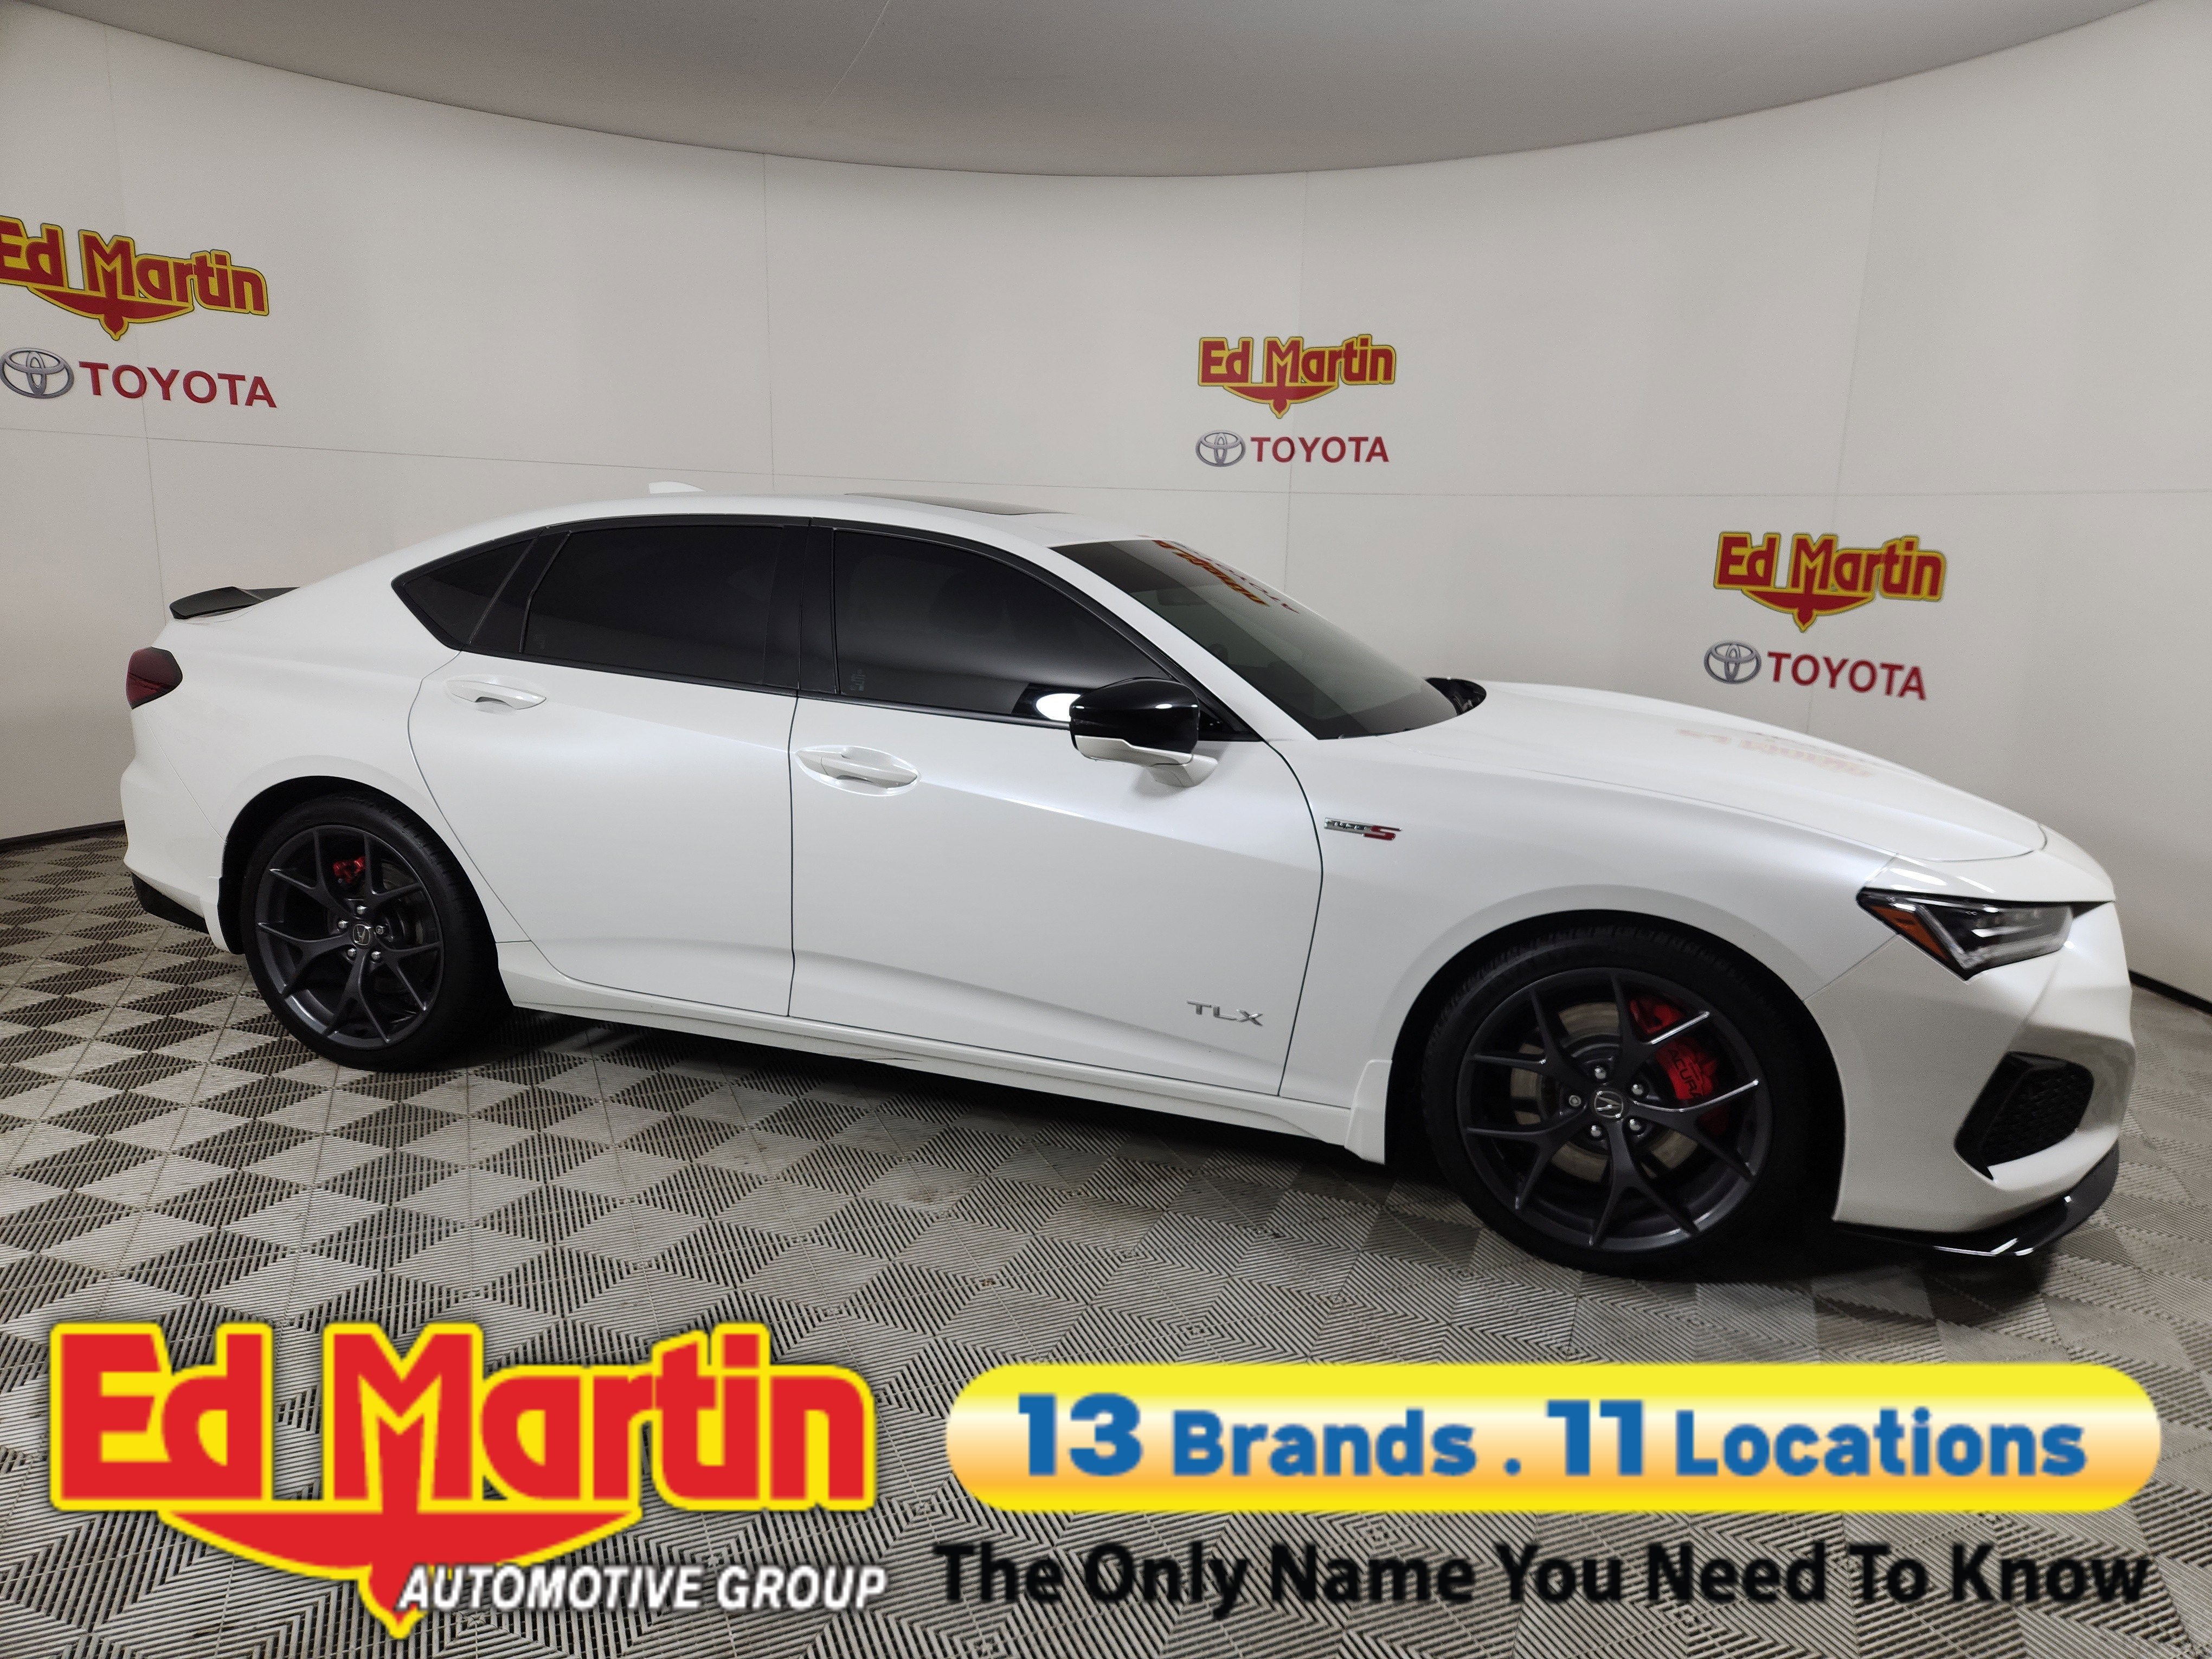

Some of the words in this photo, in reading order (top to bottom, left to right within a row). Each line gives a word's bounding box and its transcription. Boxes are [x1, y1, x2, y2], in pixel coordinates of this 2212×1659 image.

[0, 215, 68, 287] Ed
[78, 229, 269, 316] Martin
[79, 361, 277, 408] TOYOTA
[1198, 337, 1253, 386] Ed
[1263, 335, 1396, 385] Martin
[1251, 436, 1390, 463] TOYOTA
[1713, 532, 1780, 589] Ed
[1790, 532, 1946, 602] Martin
[1767, 651, 1927, 700] TOYOTA
[1187, 1001, 1263, 1026] TLX
